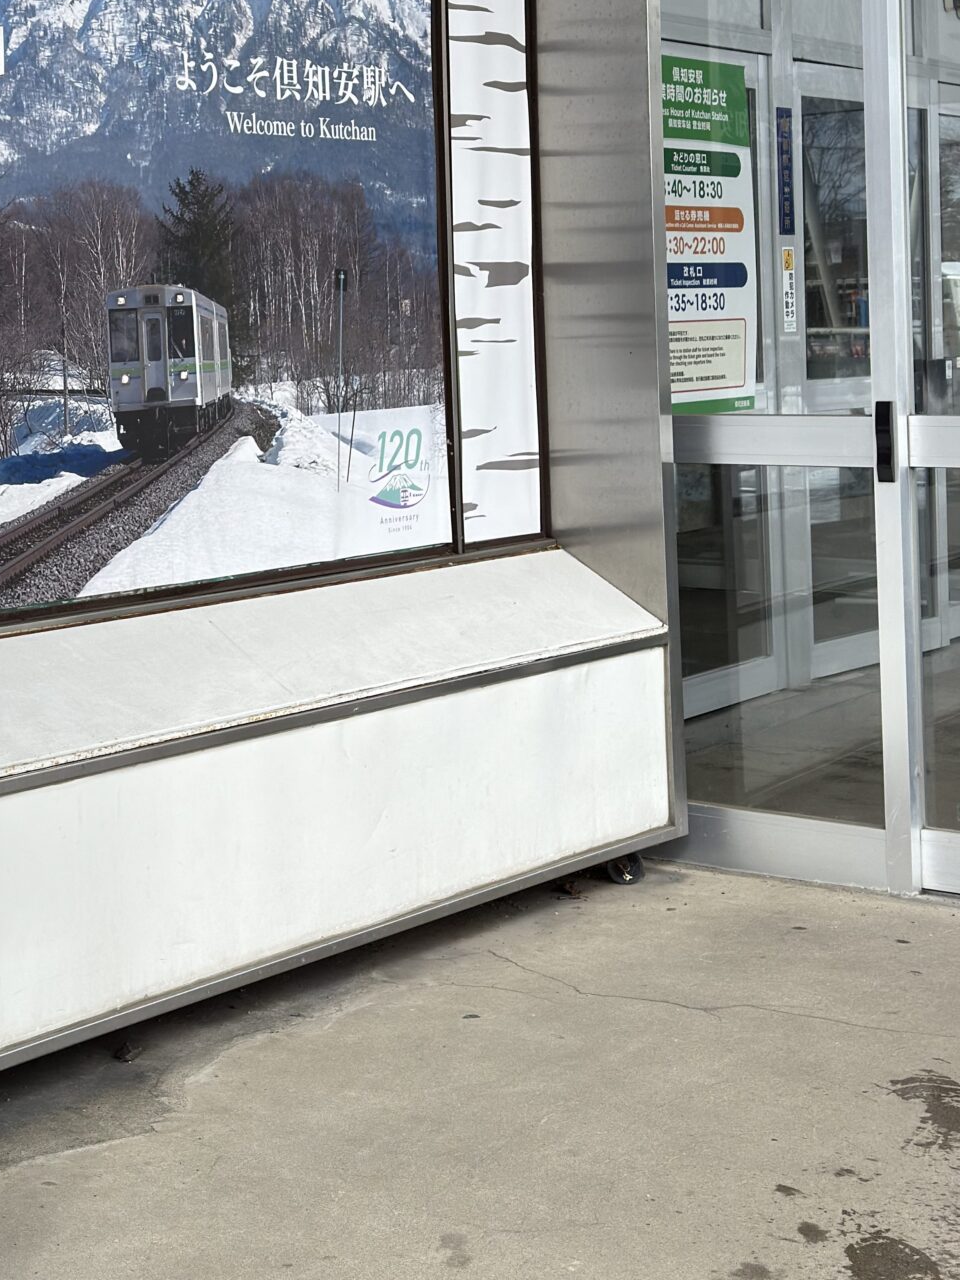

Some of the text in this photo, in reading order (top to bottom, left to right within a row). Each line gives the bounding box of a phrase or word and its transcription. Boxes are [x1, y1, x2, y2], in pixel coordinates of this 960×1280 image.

[176, 50, 415, 107] ようこそ倶知安駅へ
[225, 111, 377, 141] Welcome to Kutchan
[380, 513, 419, 524] Anniversary
